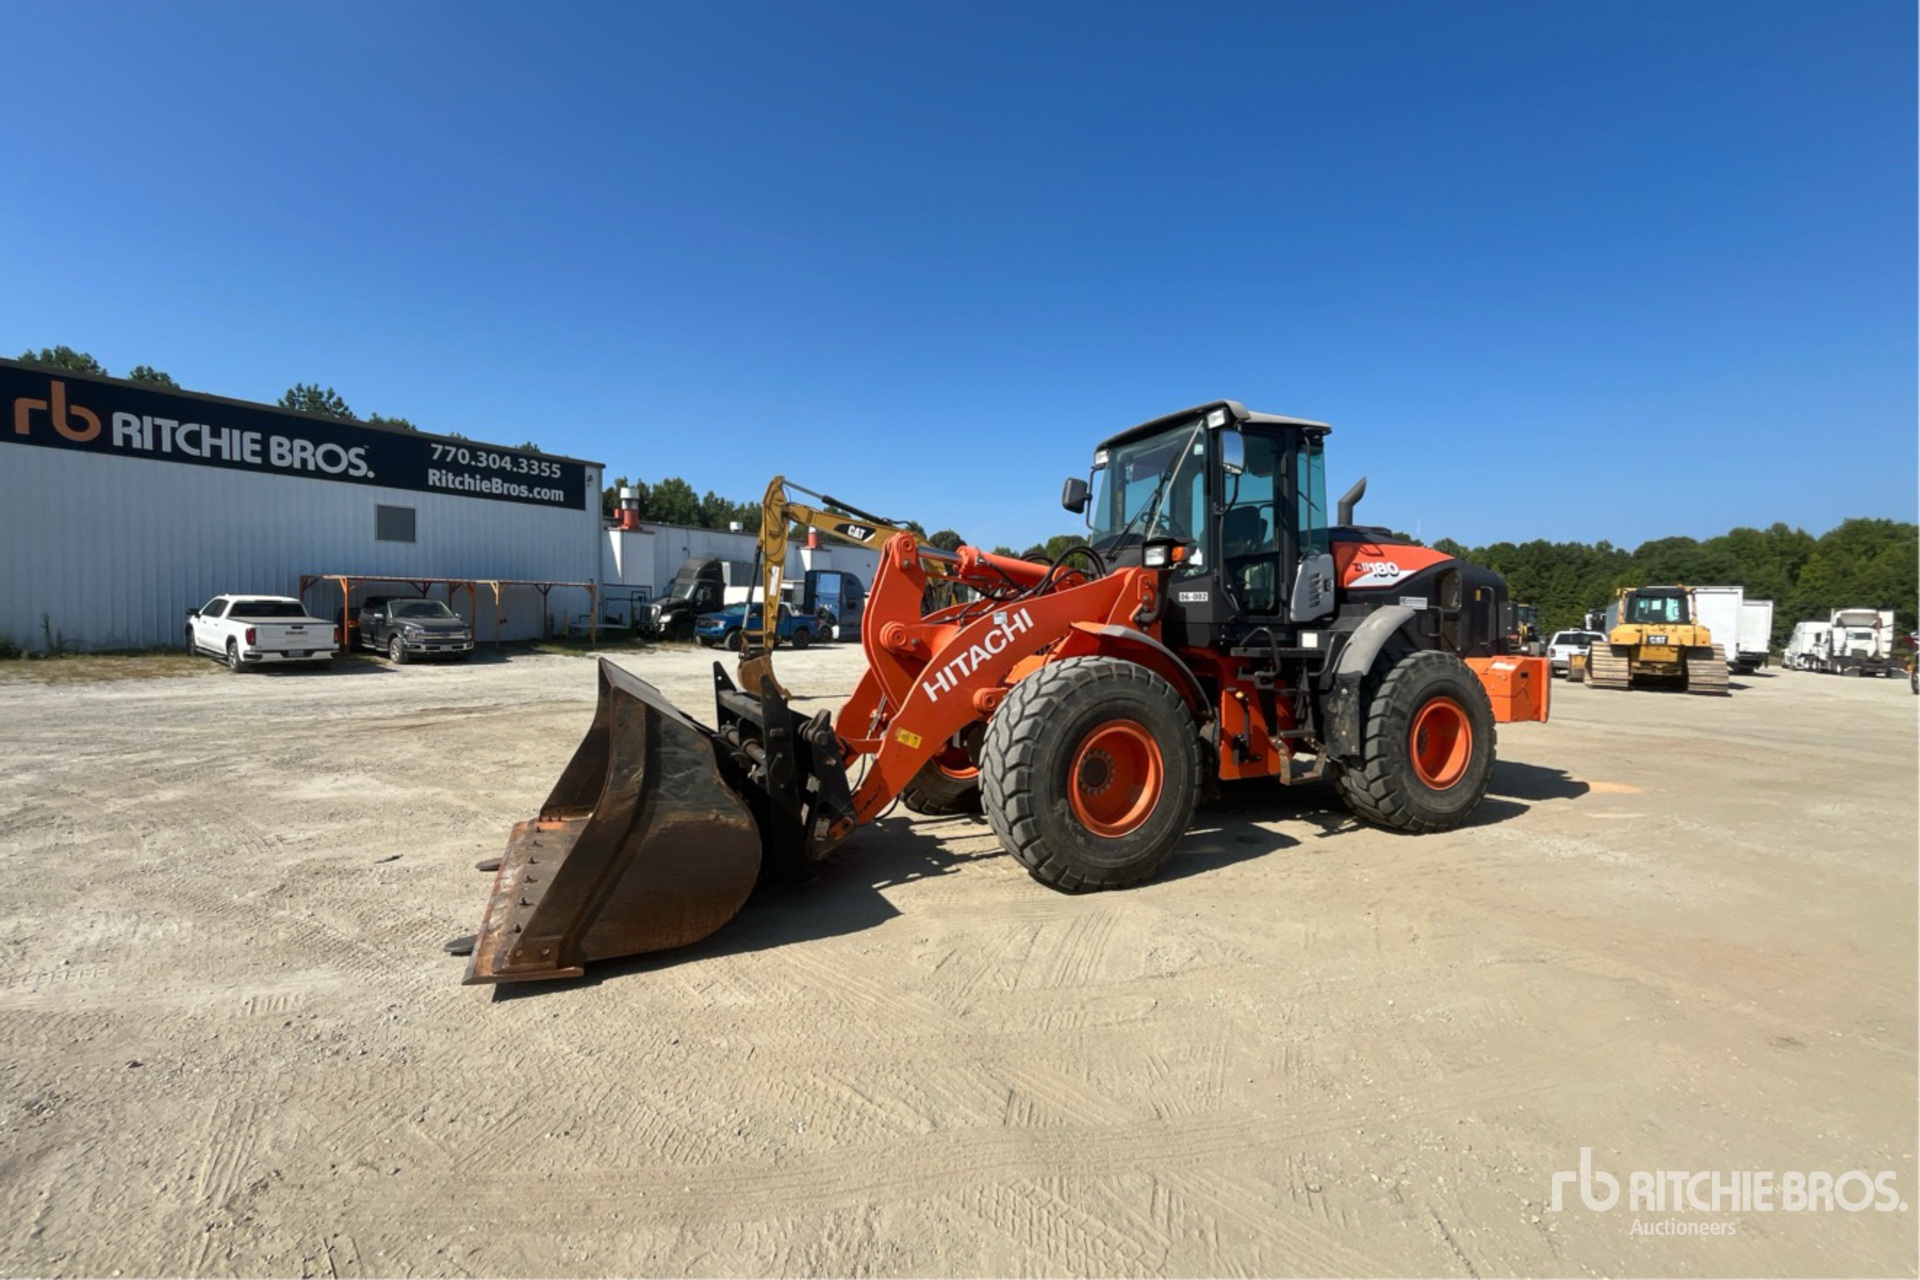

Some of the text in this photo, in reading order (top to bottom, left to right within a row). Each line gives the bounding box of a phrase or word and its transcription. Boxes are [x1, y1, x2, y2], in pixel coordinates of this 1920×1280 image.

[14, 380, 375, 479] rb RITCHIE BROS.
[431, 443, 561, 478] 770.304.3355
[427, 468, 564, 502] RitchieBros.com
[847, 525, 866, 540] CAT
[922, 607, 1034, 703] HITACHI
